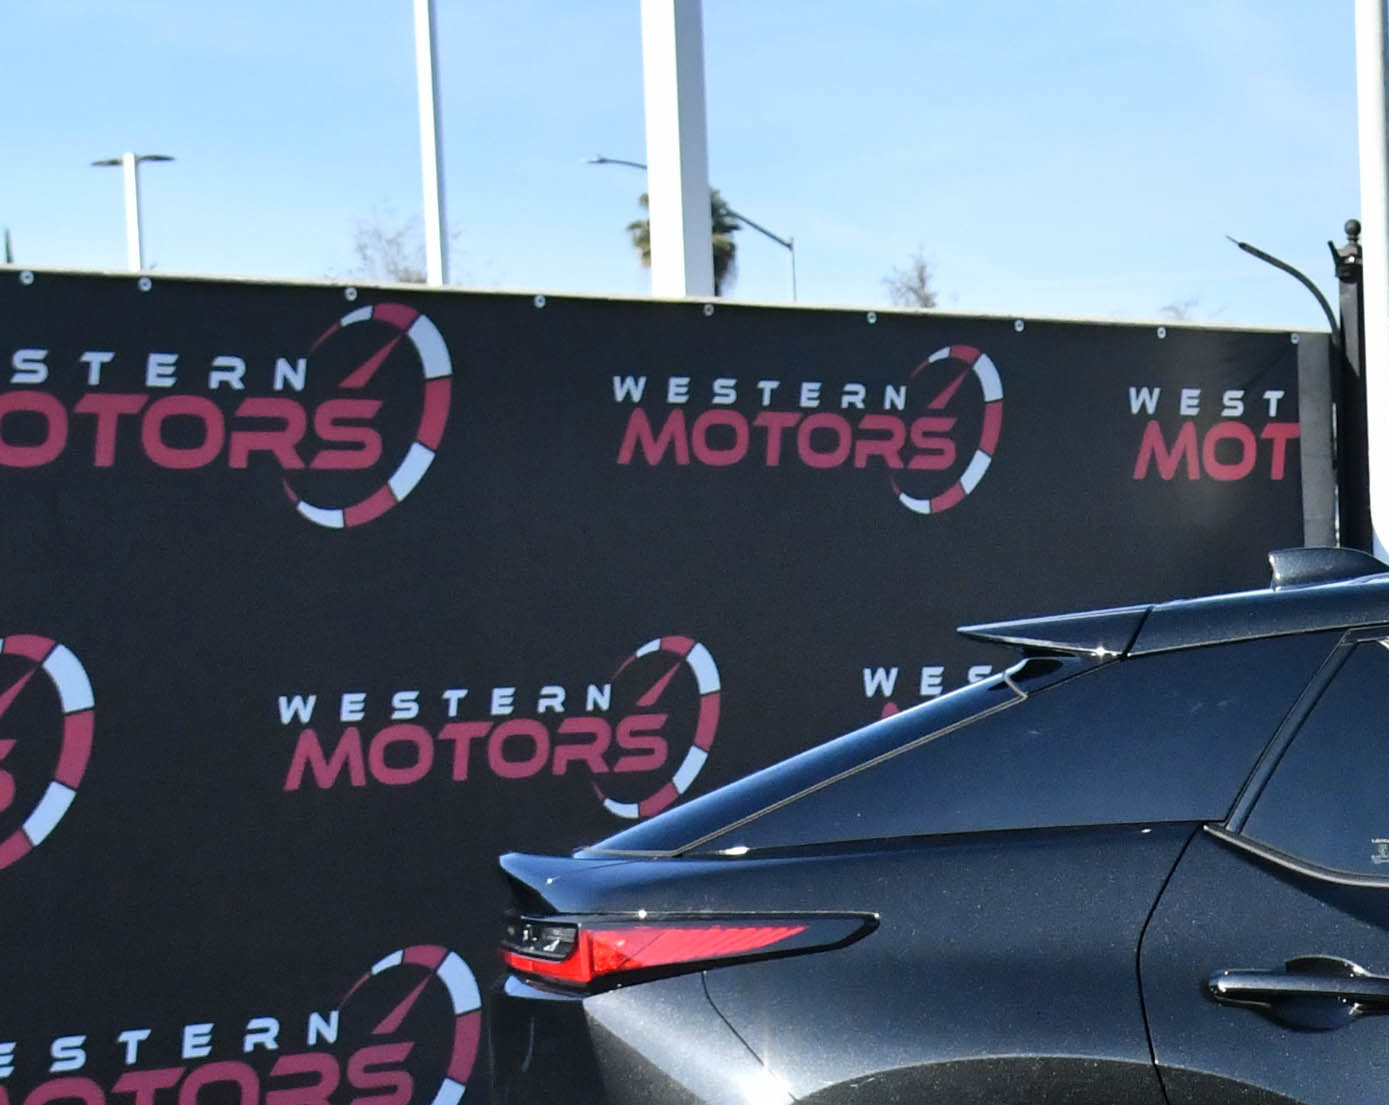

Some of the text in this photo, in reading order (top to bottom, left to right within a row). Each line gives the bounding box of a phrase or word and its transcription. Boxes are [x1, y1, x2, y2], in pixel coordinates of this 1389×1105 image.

[10, 348, 308, 391] STERN
[612, 375, 908, 412] WESTERN
[1128, 385, 1286, 418] WEST
[0, 390, 383, 470] OTORS
[617, 406, 957, 471] MOTORS
[1133, 419, 1301, 481] MOT
[277, 682, 612, 726] WESTERN
[284, 712, 669, 791] MOTORS
